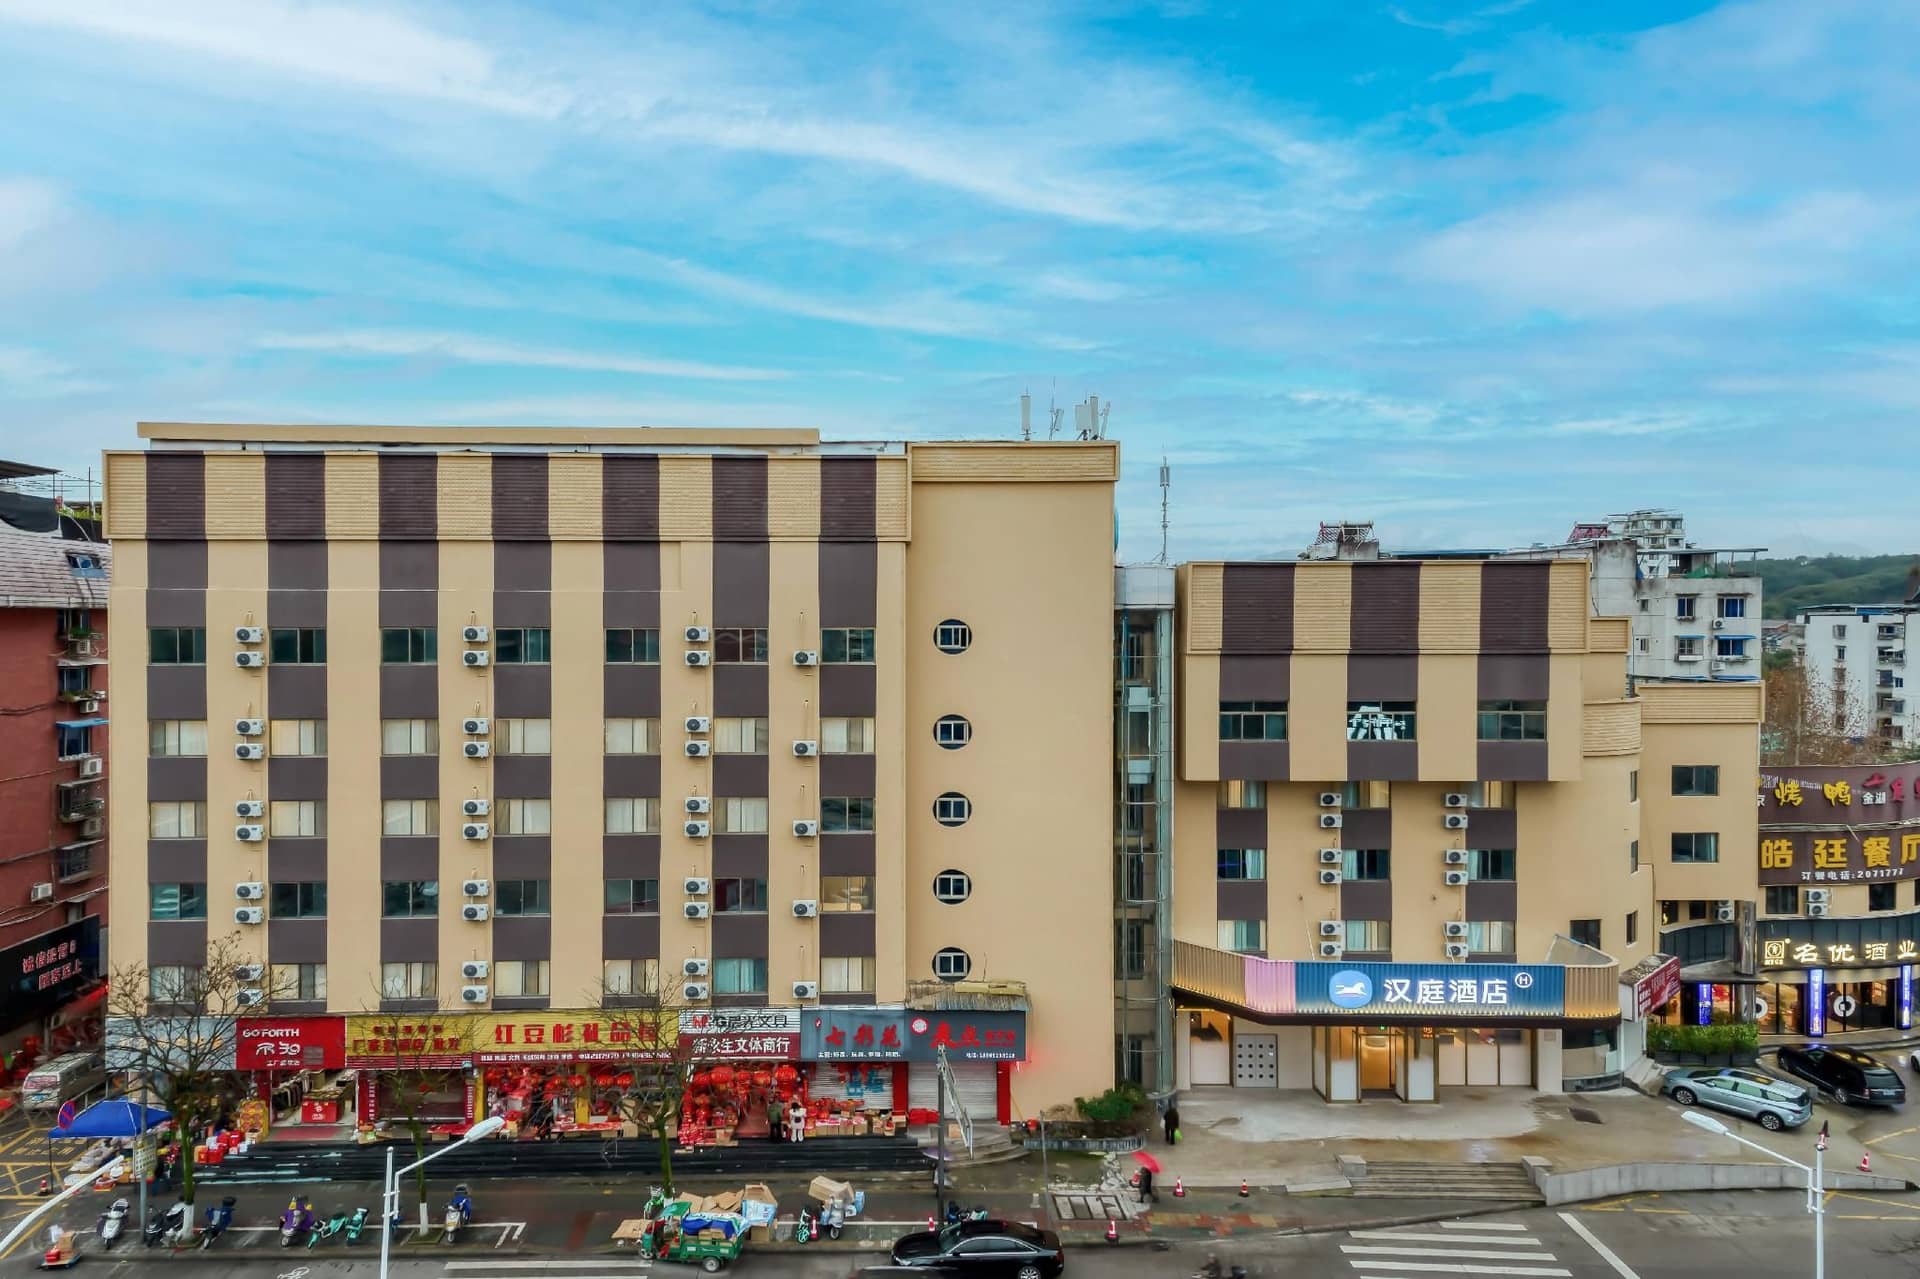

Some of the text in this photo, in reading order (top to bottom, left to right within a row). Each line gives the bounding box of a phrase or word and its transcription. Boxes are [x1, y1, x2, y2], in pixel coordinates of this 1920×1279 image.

[1775, 778, 1852, 807] 烤鸭
[1793, 940, 1917, 963] 名优酒业
[1384, 979, 1508, 1004] 汉庭酒店
[242, 1028, 300, 1038] GO FORTH
